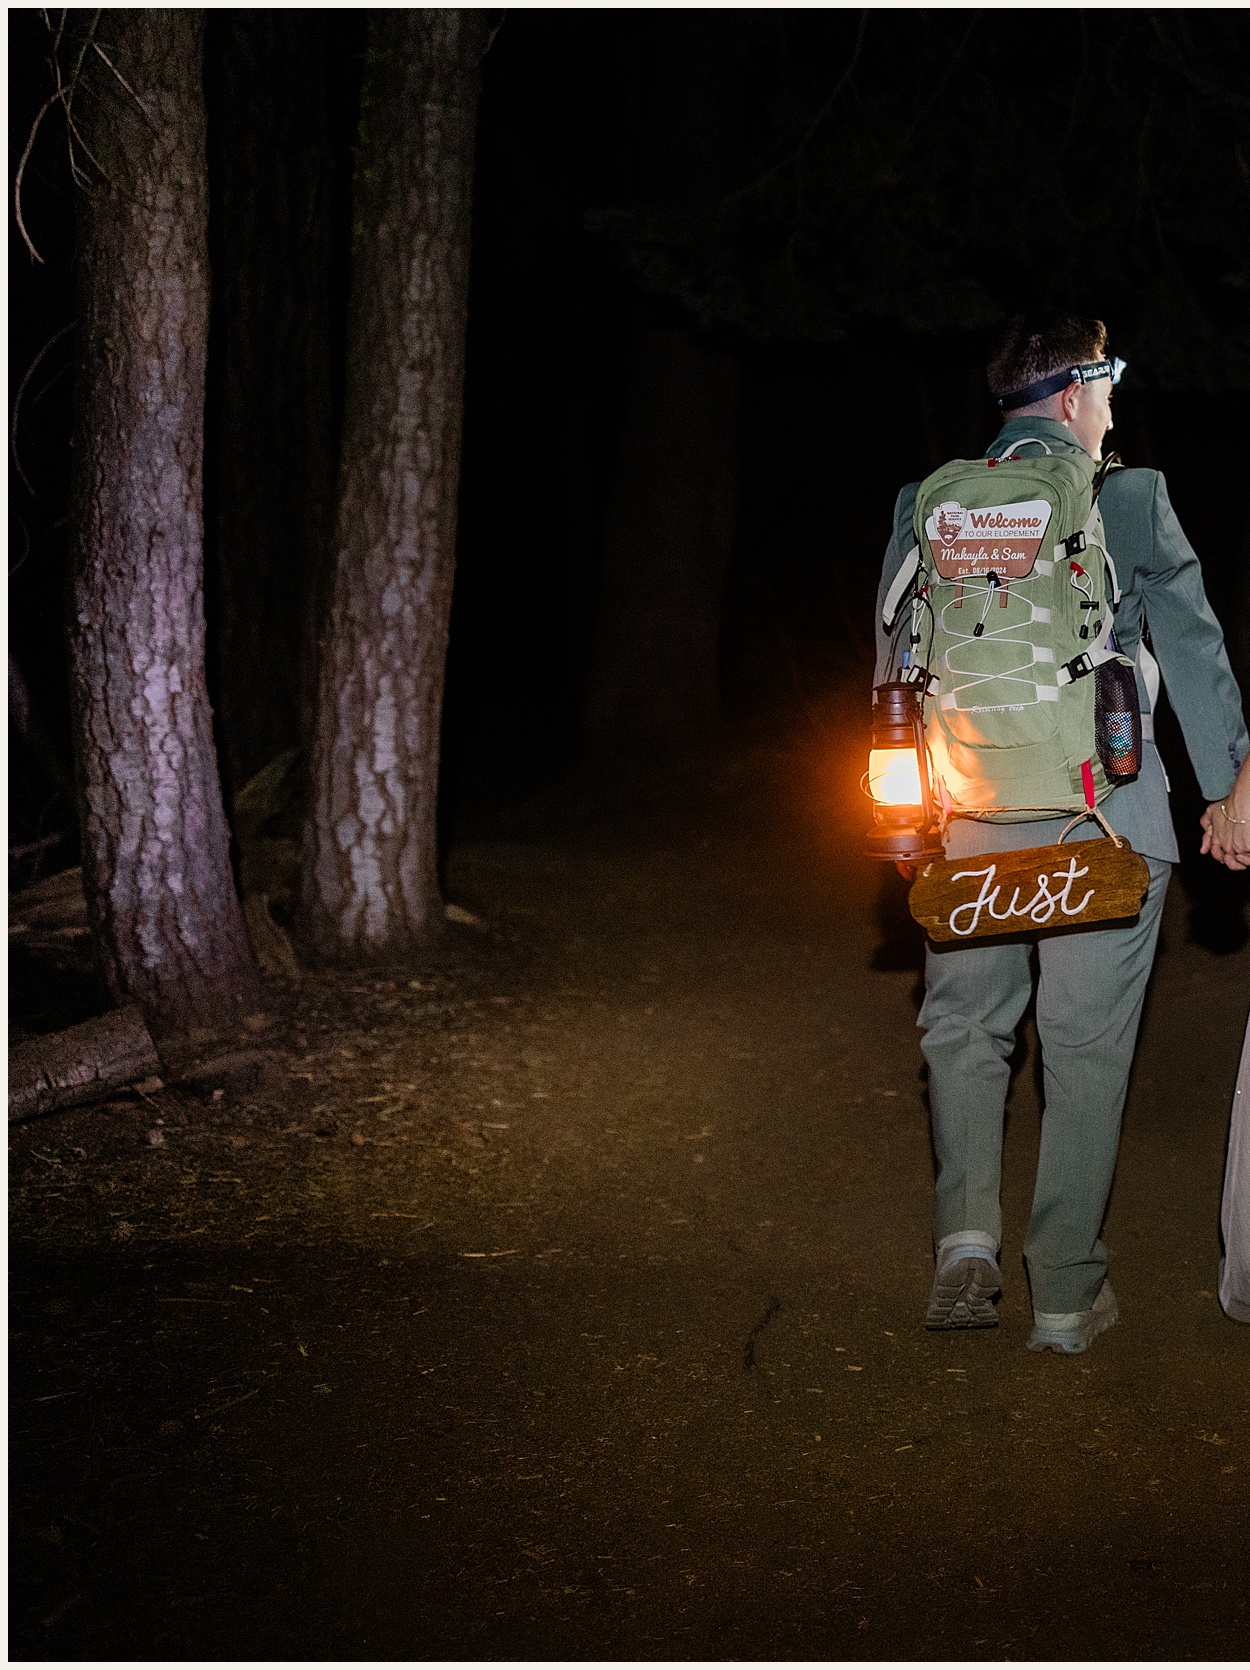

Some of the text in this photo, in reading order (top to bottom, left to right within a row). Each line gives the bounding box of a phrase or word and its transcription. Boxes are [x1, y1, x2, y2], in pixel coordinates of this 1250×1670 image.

[970, 512, 1042, 529] Welcome
[941, 547, 1027, 566] Makayla & Sam
[958, 567, 970, 575] Est.
[949, 857, 1095, 936] Just
